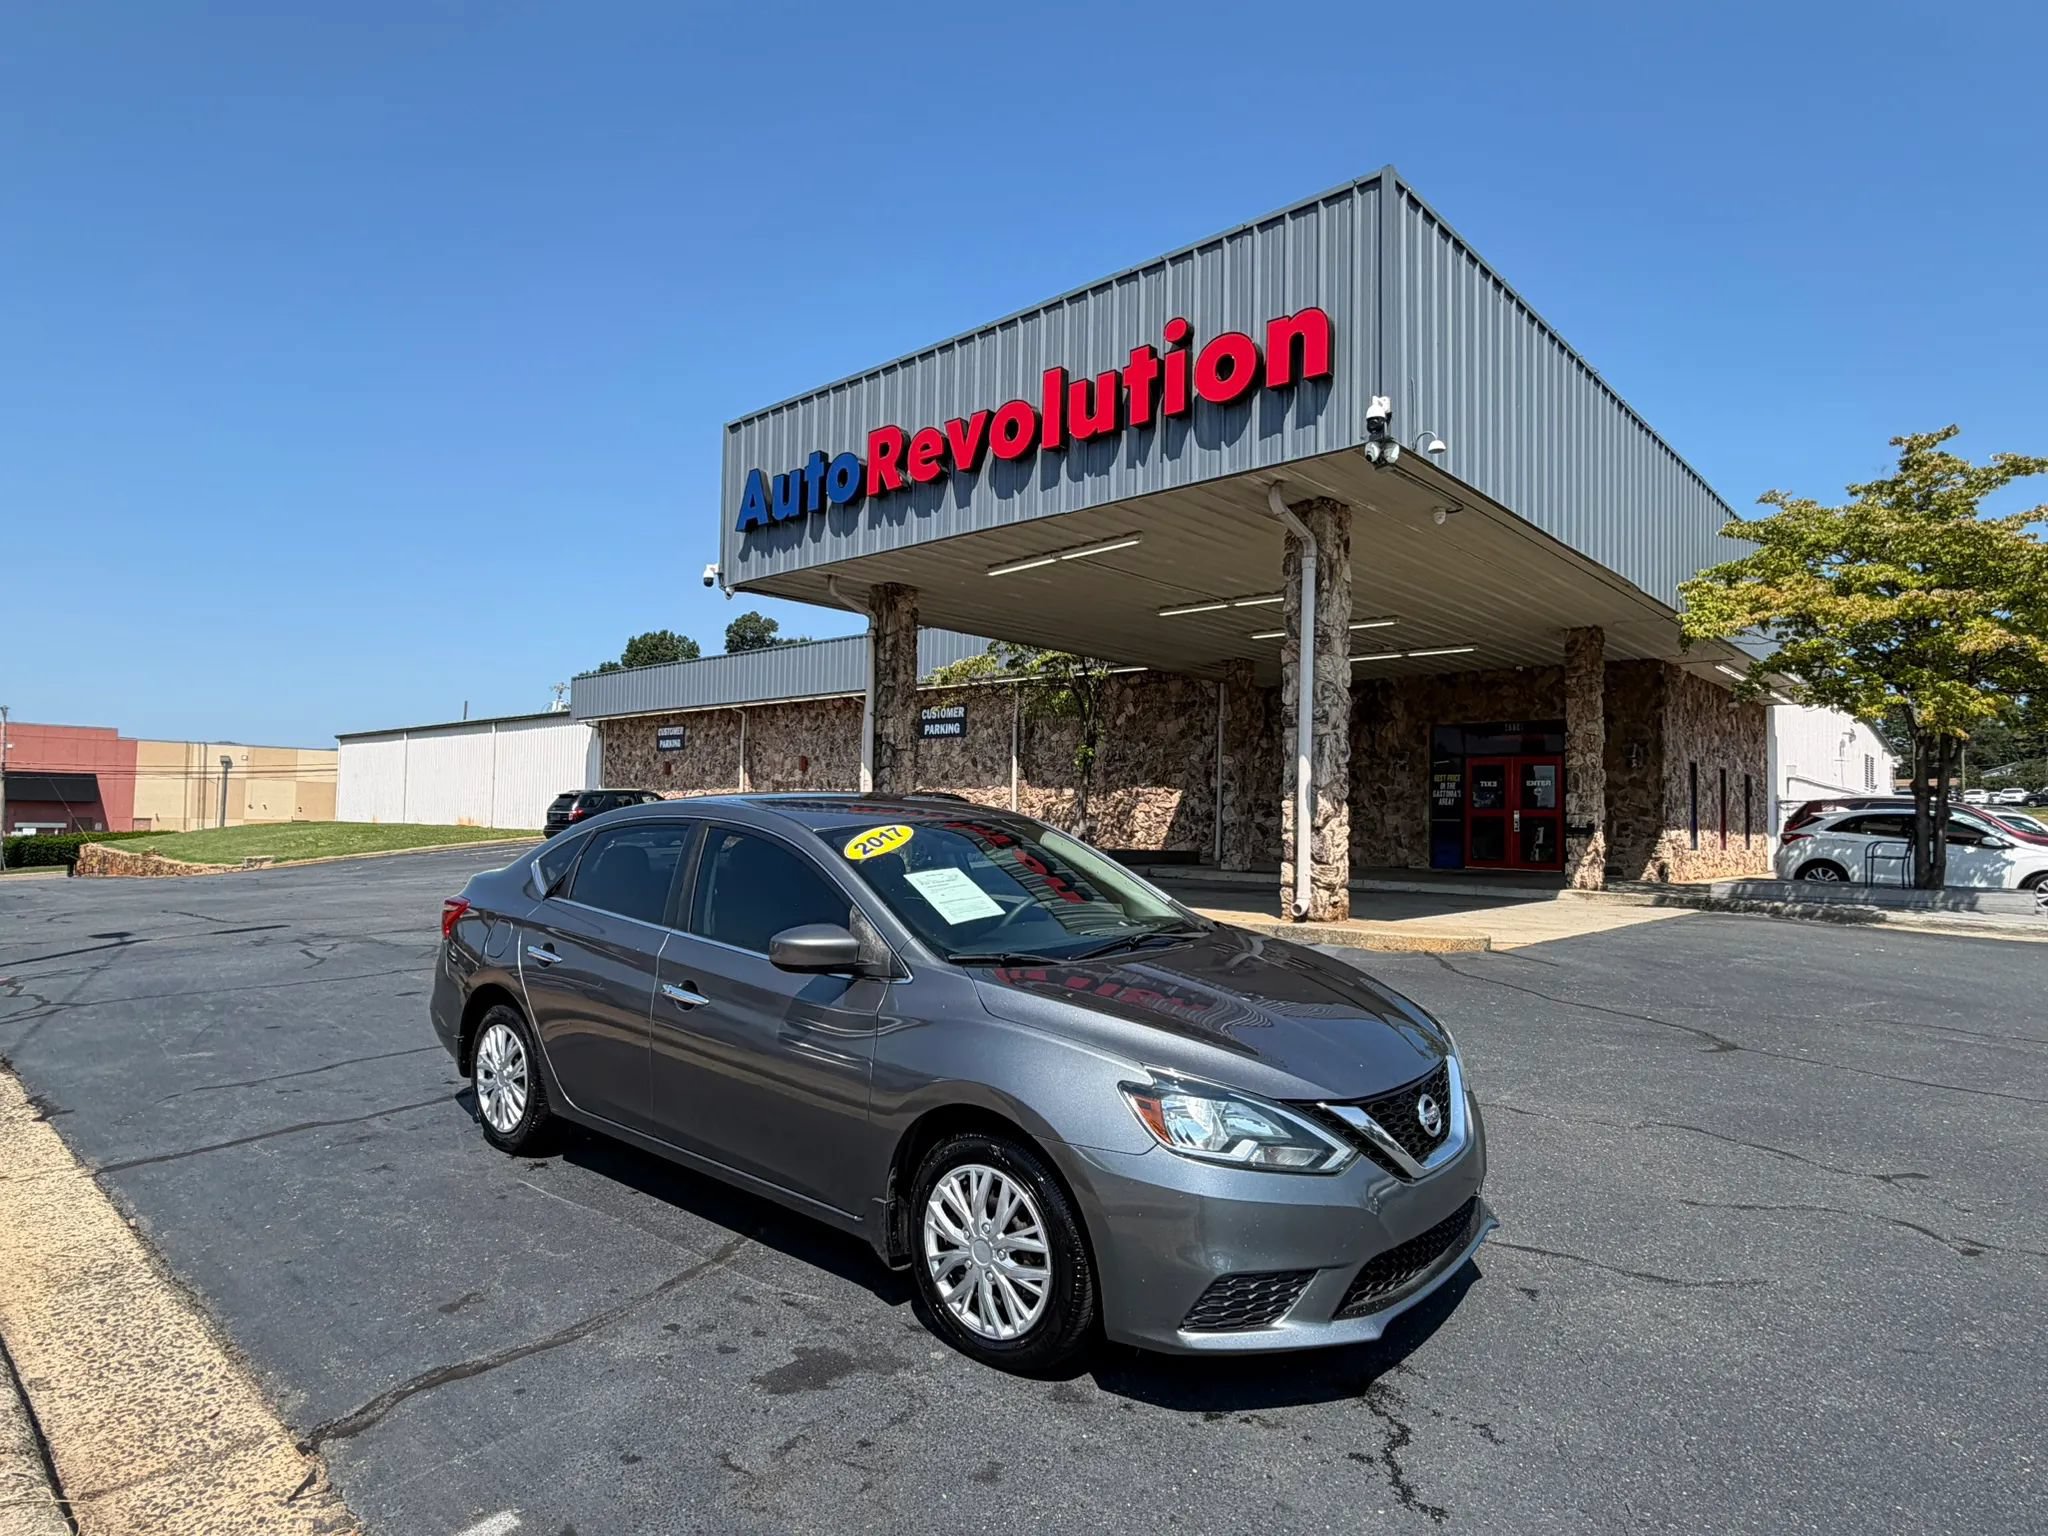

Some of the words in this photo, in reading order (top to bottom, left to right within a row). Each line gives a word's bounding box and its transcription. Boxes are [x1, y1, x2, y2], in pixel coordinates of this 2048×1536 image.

[735, 306, 1333, 533] AutoRevolution
[921, 706, 965, 720] CUSTOMER
[657, 726, 684, 736] CUSTOMER
[923, 722, 961, 736] PARKING
[659, 739, 681, 748] PARKING
[854, 827, 904, 854] 2017
